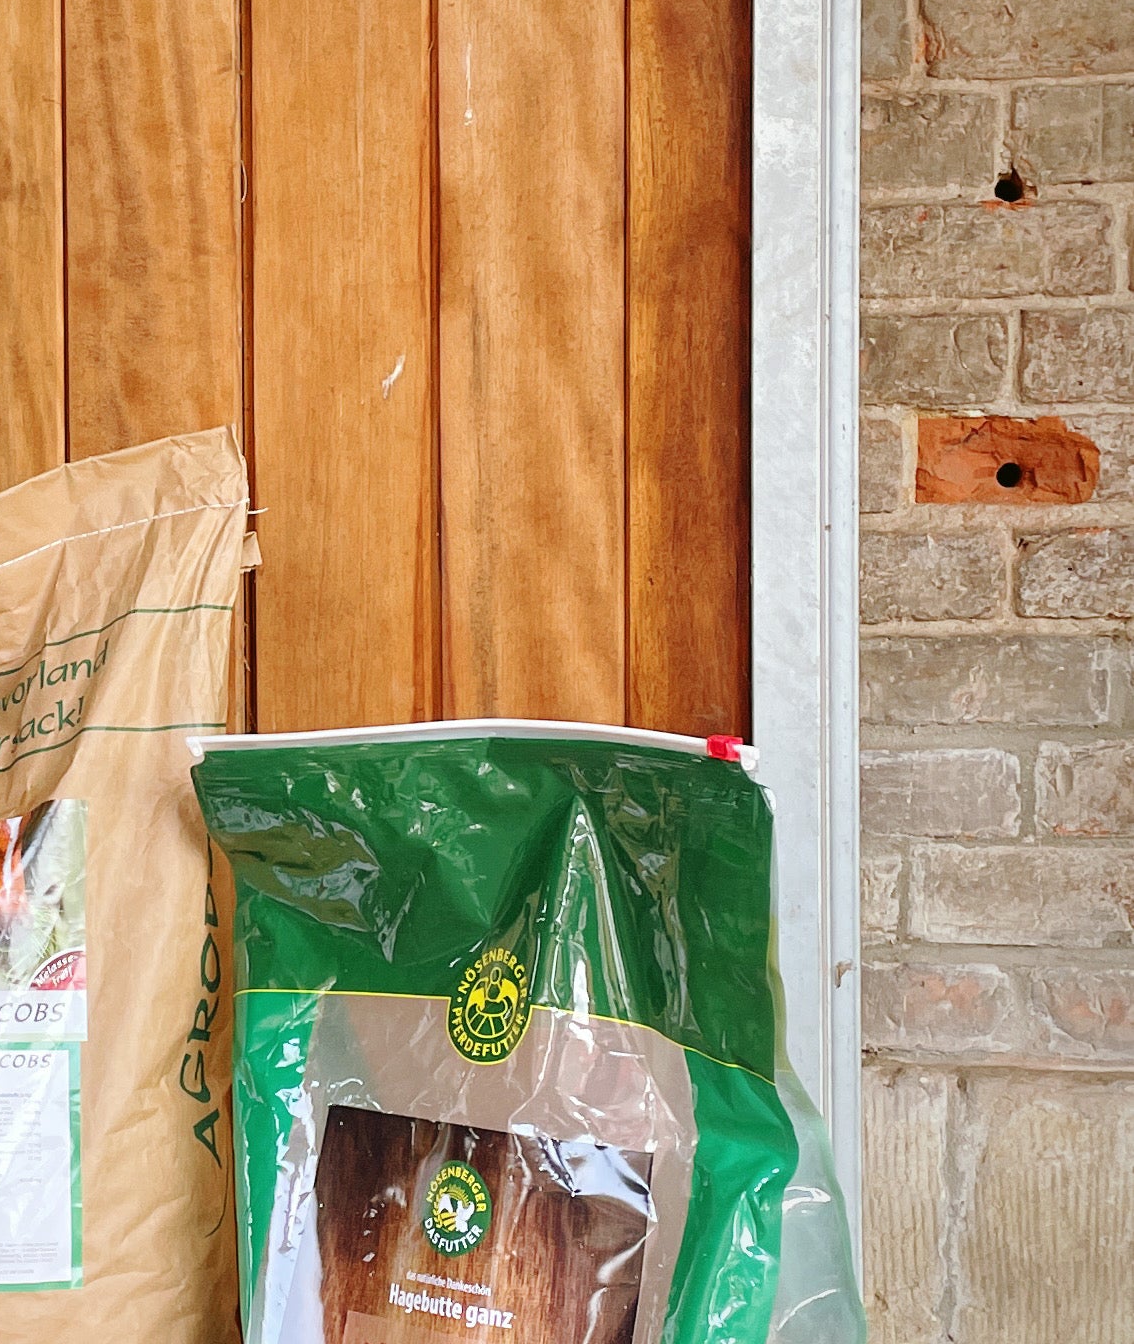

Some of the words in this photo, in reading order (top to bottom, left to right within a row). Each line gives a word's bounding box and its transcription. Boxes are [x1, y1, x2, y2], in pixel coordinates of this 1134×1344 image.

[451, 1007, 526, 1057] PFERDEFUTTER
[389, 1282, 463, 1320] Hagebutte
[465, 1304, 514, 1329] ganz
[446, 1276, 492, 1297] Dankeschön
